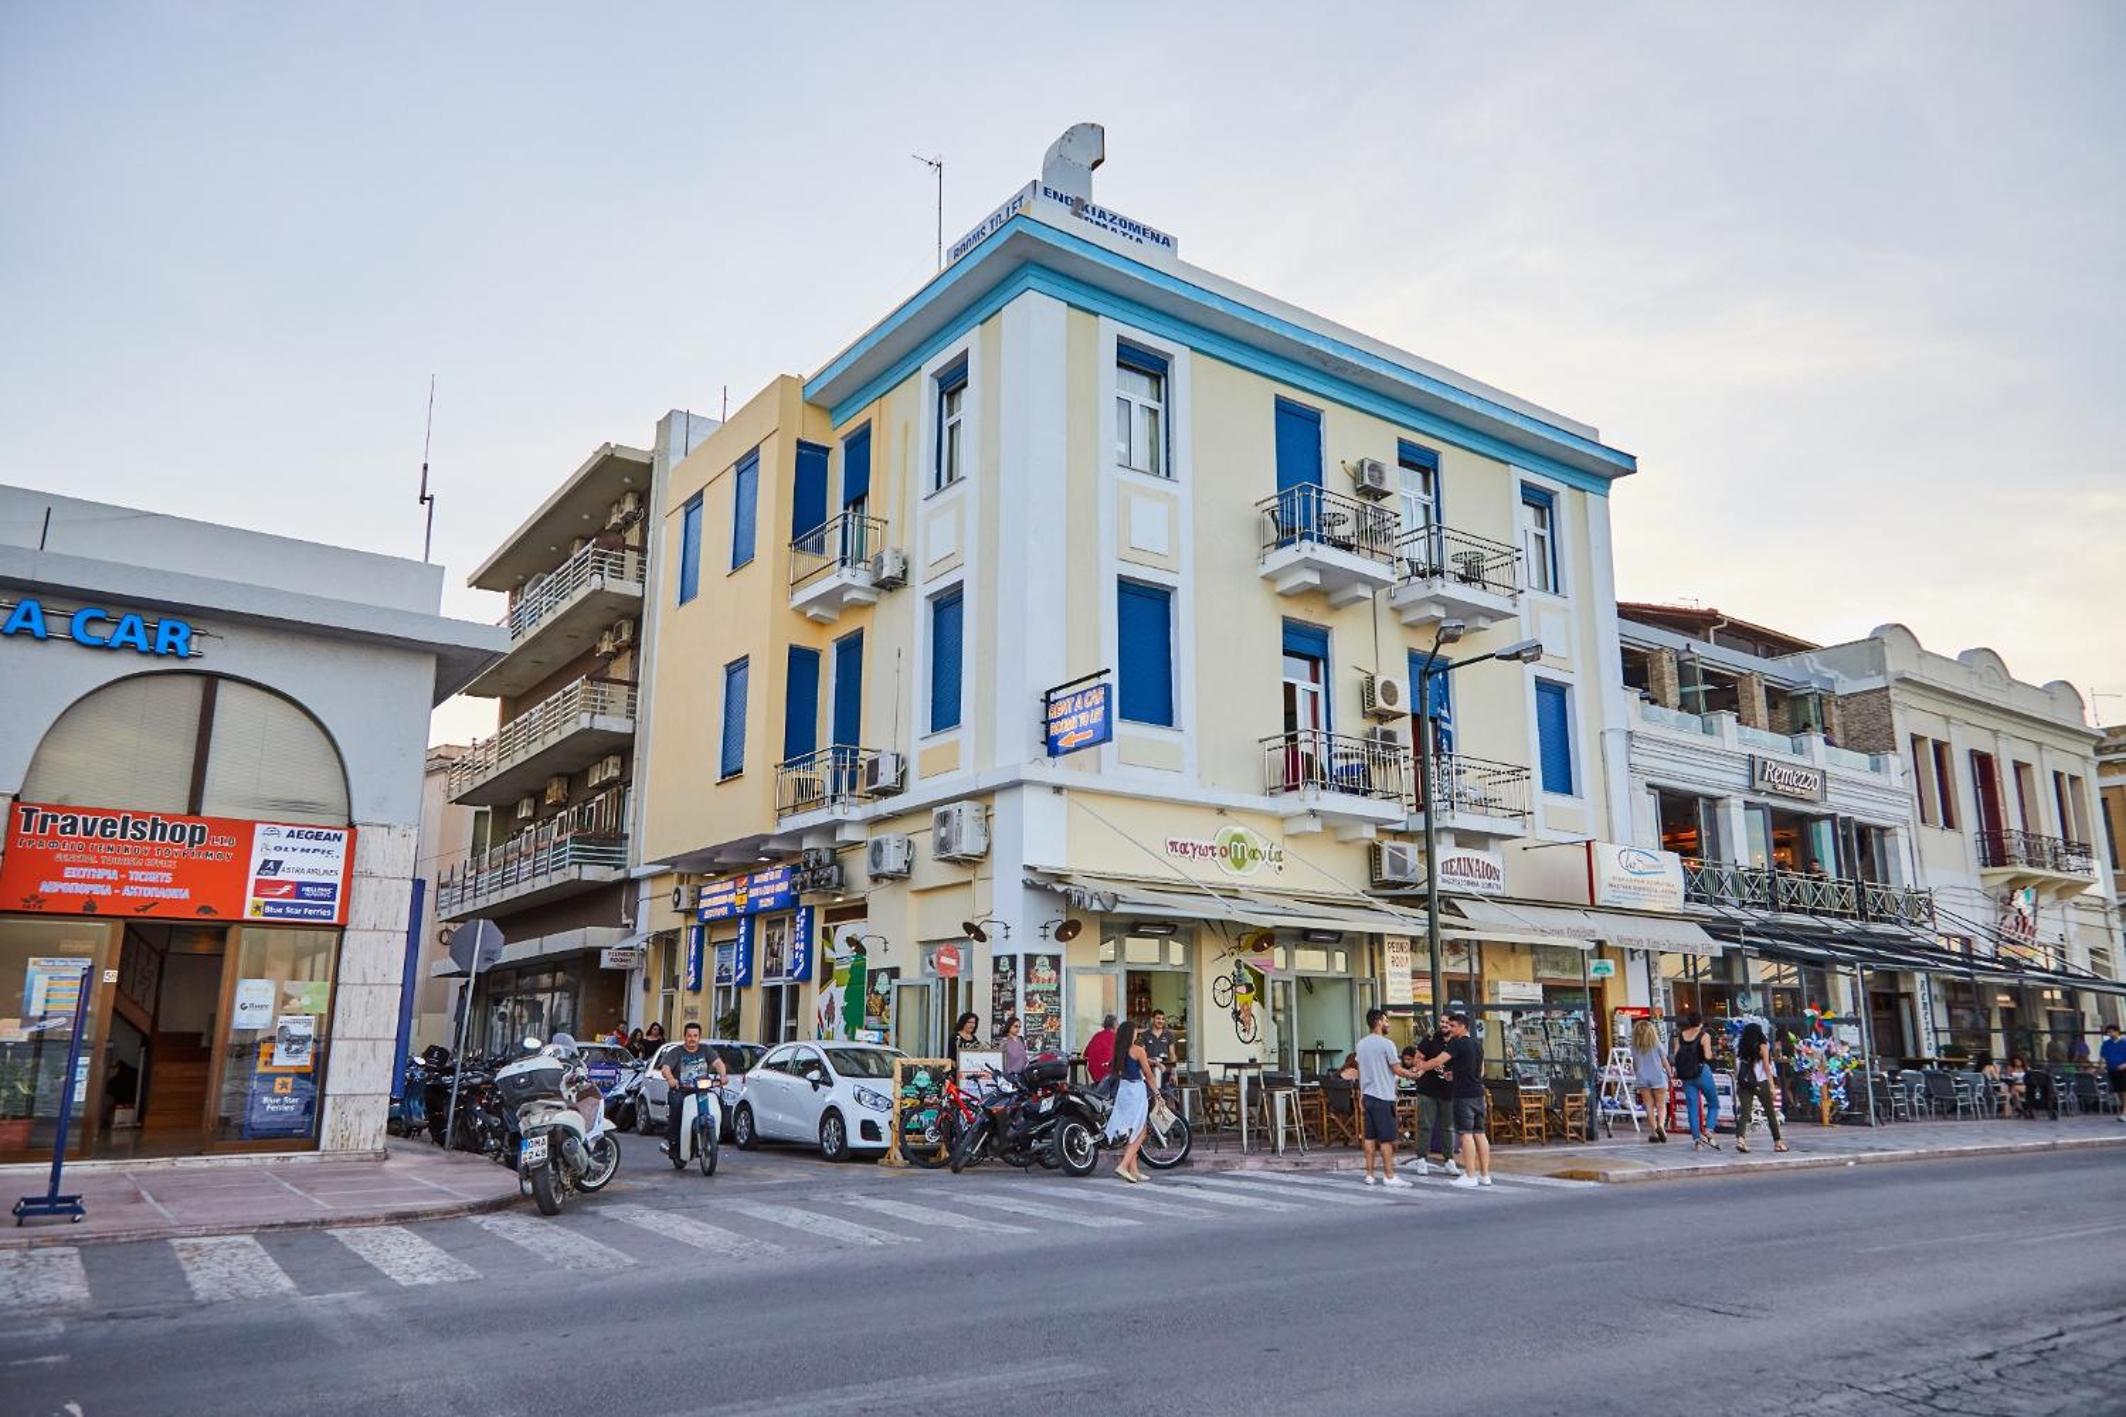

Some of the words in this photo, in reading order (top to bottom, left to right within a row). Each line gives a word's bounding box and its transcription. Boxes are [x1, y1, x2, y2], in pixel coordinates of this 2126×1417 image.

[1043, 186, 1171, 248] ΕΝΟΚΙΑΖΟΜΕΝΑ
[1, 598, 47, 641] A
[70, 606, 193, 660] CAR
[1764, 760, 1820, 790] Remezzo
[19, 806, 209, 849] Travelshop
[286, 829, 343, 843] AEGEAN
[17, 838, 85, 851] ΓΡΑΦΕΙΟ
[89, 842, 150, 856] ΓΕΝΙΚΟΥ
[154, 846, 235, 863] ΤΟΥΡΙΣΜΟΥ
[273, 845, 335, 855] OLYMPIC
[1441, 857, 1500, 881] ΠΕΛΙΝΑΙΟΝ
[264, 905, 283, 913] Blue
[285, 906, 302, 915] Star
[303, 908, 331, 916] Ferries
[262, 1096, 282, 1105] Blue
[283, 1096, 300, 1104] Star
[265, 1103, 295, 1113] Ferries
